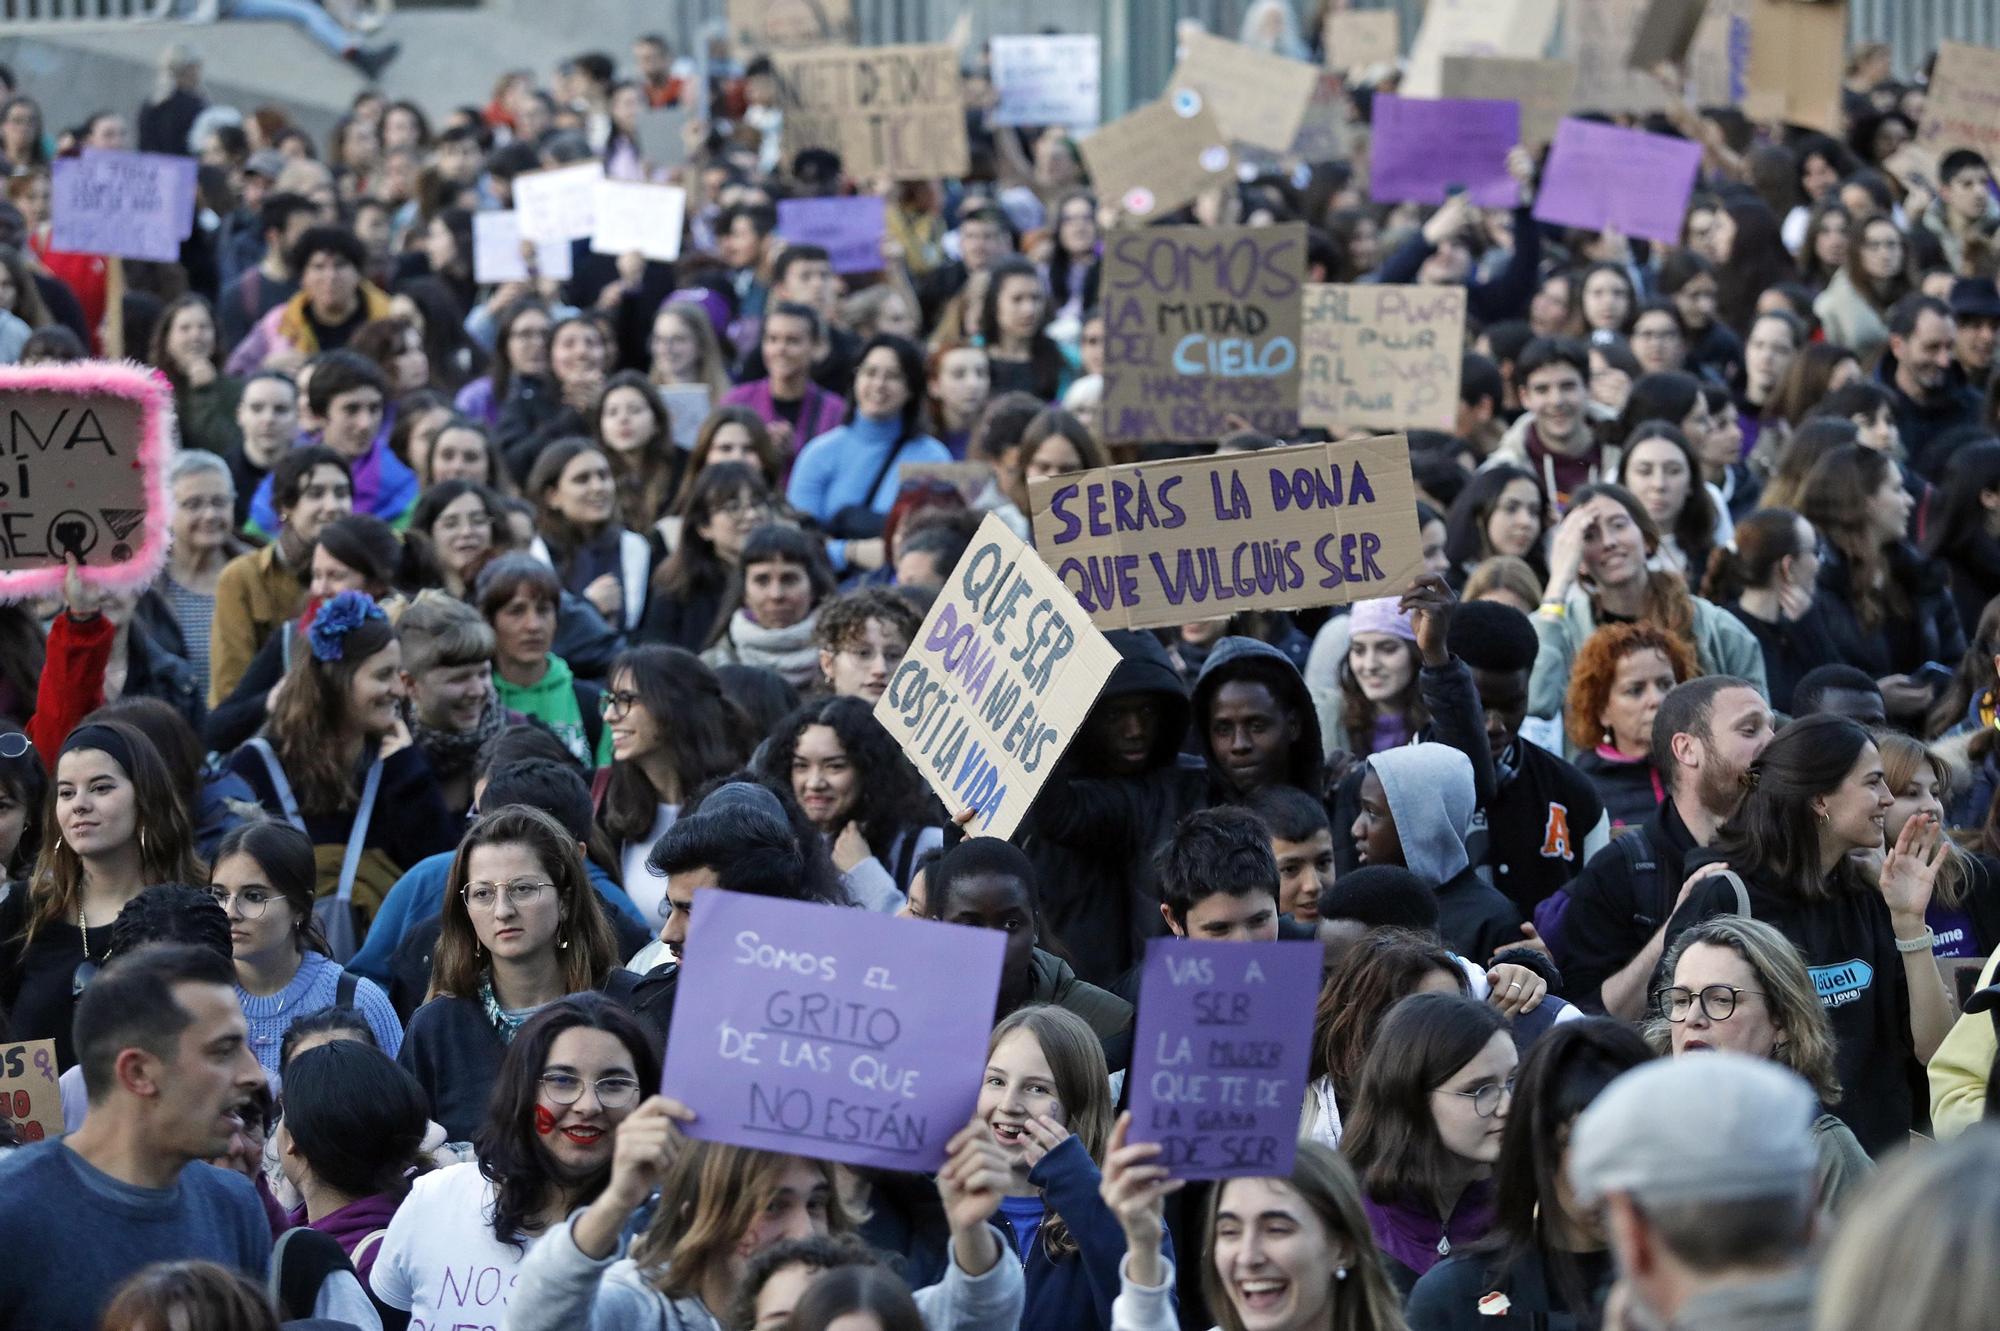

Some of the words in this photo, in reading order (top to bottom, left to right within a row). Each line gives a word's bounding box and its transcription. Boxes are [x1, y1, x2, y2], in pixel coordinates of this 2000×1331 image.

[1113, 236, 1297, 298] SOMOS
[1105, 296, 1144, 333] LA
[1157, 302, 1269, 336] MITAD
[1375, 288, 1461, 325] PWR
[1104, 334, 1158, 366] DEL
[1172, 333, 1297, 377] CIELO
[1357, 327, 1437, 350] PWR
[0, 407, 117, 457] NA
[1051, 468, 1187, 545] SERÀS
[1209, 468, 1252, 521] LA
[1269, 460, 1376, 512] DONA
[1058, 554, 1141, 614] QUE
[1314, 532, 1386, 590] SER
[962, 542, 1034, 645] QUE
[1009, 598, 1075, 697] SER
[924, 602, 997, 706] DONA
[978, 668, 1022, 733] NO
[1001, 700, 1058, 773] ENS
[930, 716, 970, 782] LA
[952, 740, 1008, 832] VIDA
[1540, 802, 1575, 862] A
[863, 966, 897, 990] EL
[1165, 954, 1216, 987] VAS
[1244, 959, 1267, 985] A
[1192, 990, 1251, 1021] SER
[718, 1023, 767, 1065] DE
[778, 1040, 832, 1073] LAS
[849, 1054, 920, 1099] QUE
[1156, 1030, 1194, 1065] LA
[1207, 1039, 1283, 1067] MUJER
[1151, 1069, 1210, 1104] QUE
[1217, 1075, 1247, 1106] TE
[1256, 1078, 1289, 1107] DE
[749, 1081, 814, 1132] NO
[823, 1097, 928, 1149] ESTÁN
[1151, 1106, 1181, 1130] LA
[1193, 1109, 1256, 1131] GANA
[1159, 1135, 1211, 1167] DE
[1220, 1135, 1279, 1167] SER
